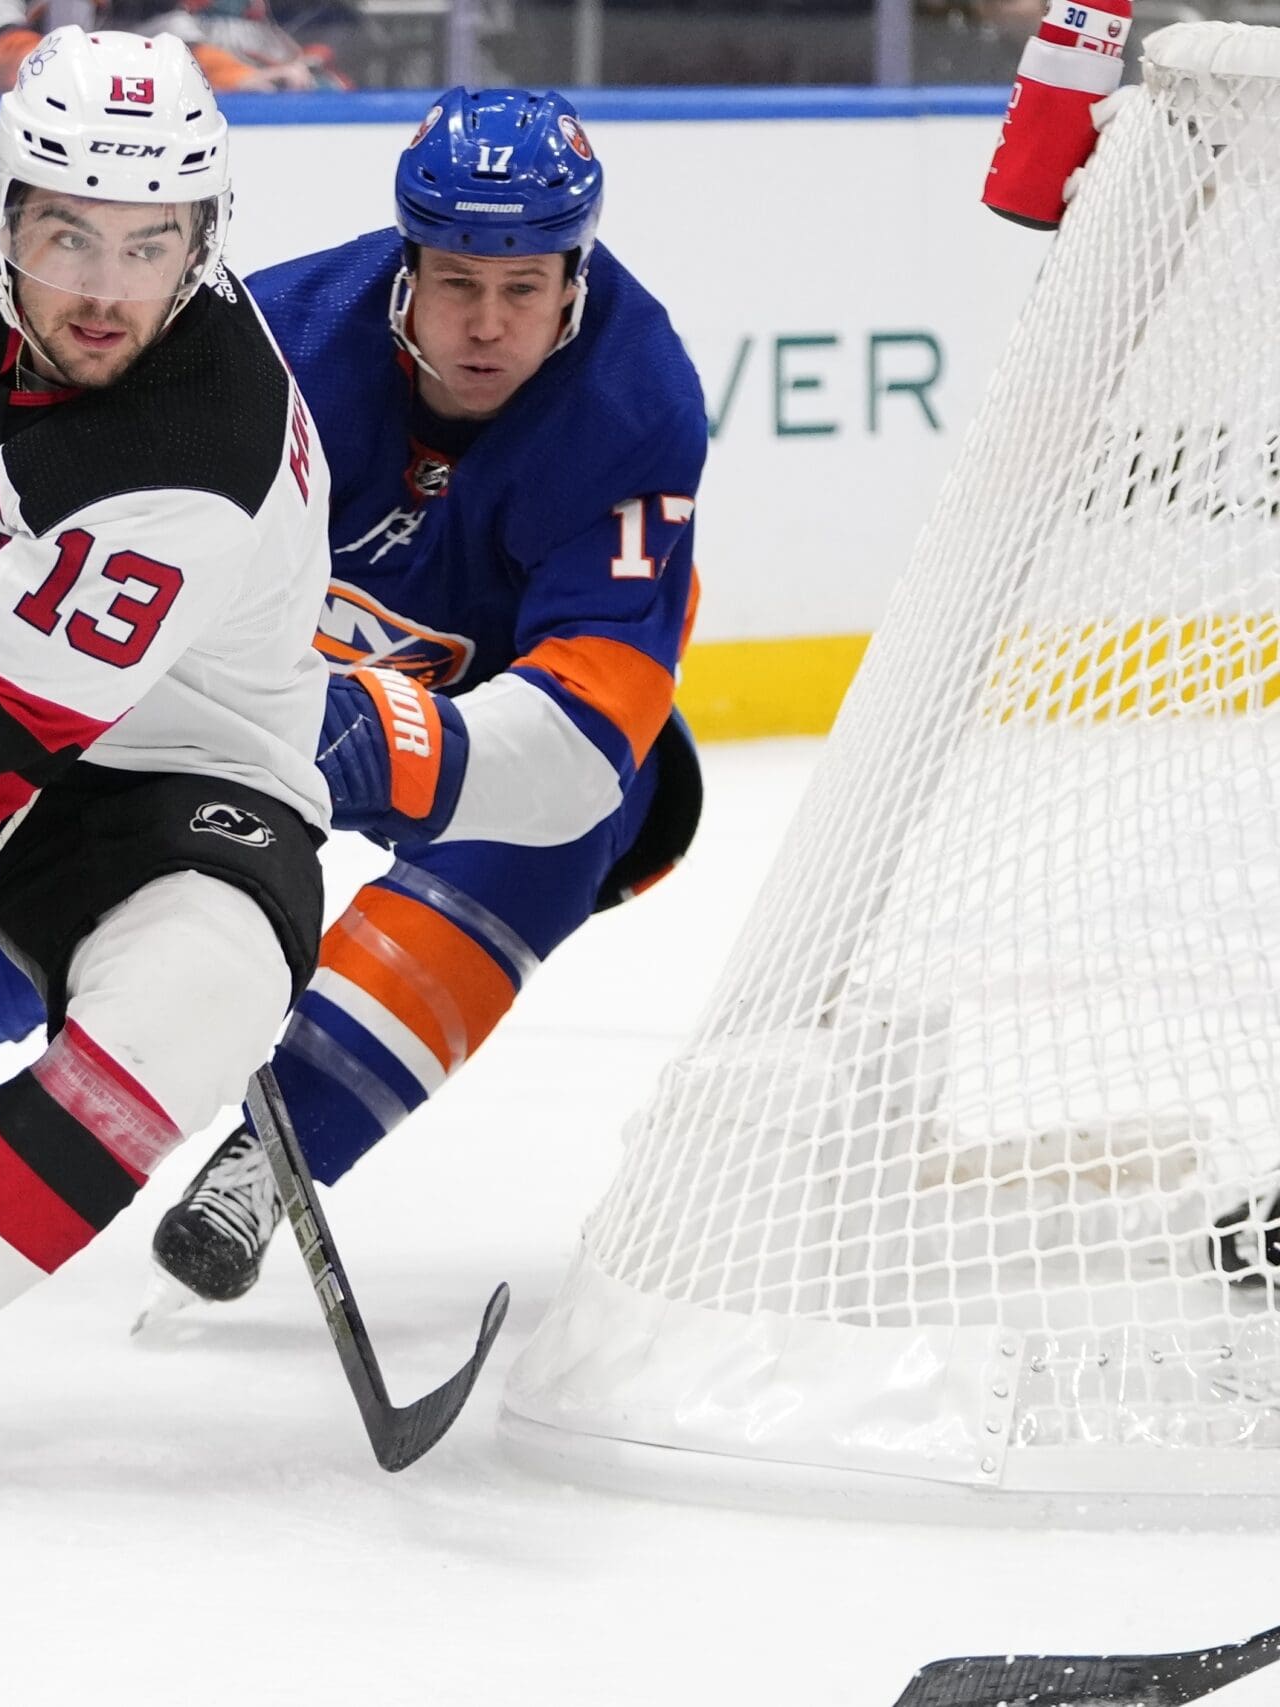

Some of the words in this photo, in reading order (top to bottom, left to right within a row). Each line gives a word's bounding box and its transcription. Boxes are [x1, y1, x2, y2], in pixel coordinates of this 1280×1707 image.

[1064, 7, 1088, 29] 30
[109, 74, 155, 104] 13
[89, 140, 167, 158] CCM
[476, 145, 514, 173] 17
[455, 201, 524, 214] WARRIOR
[13, 527, 185, 670] 13
